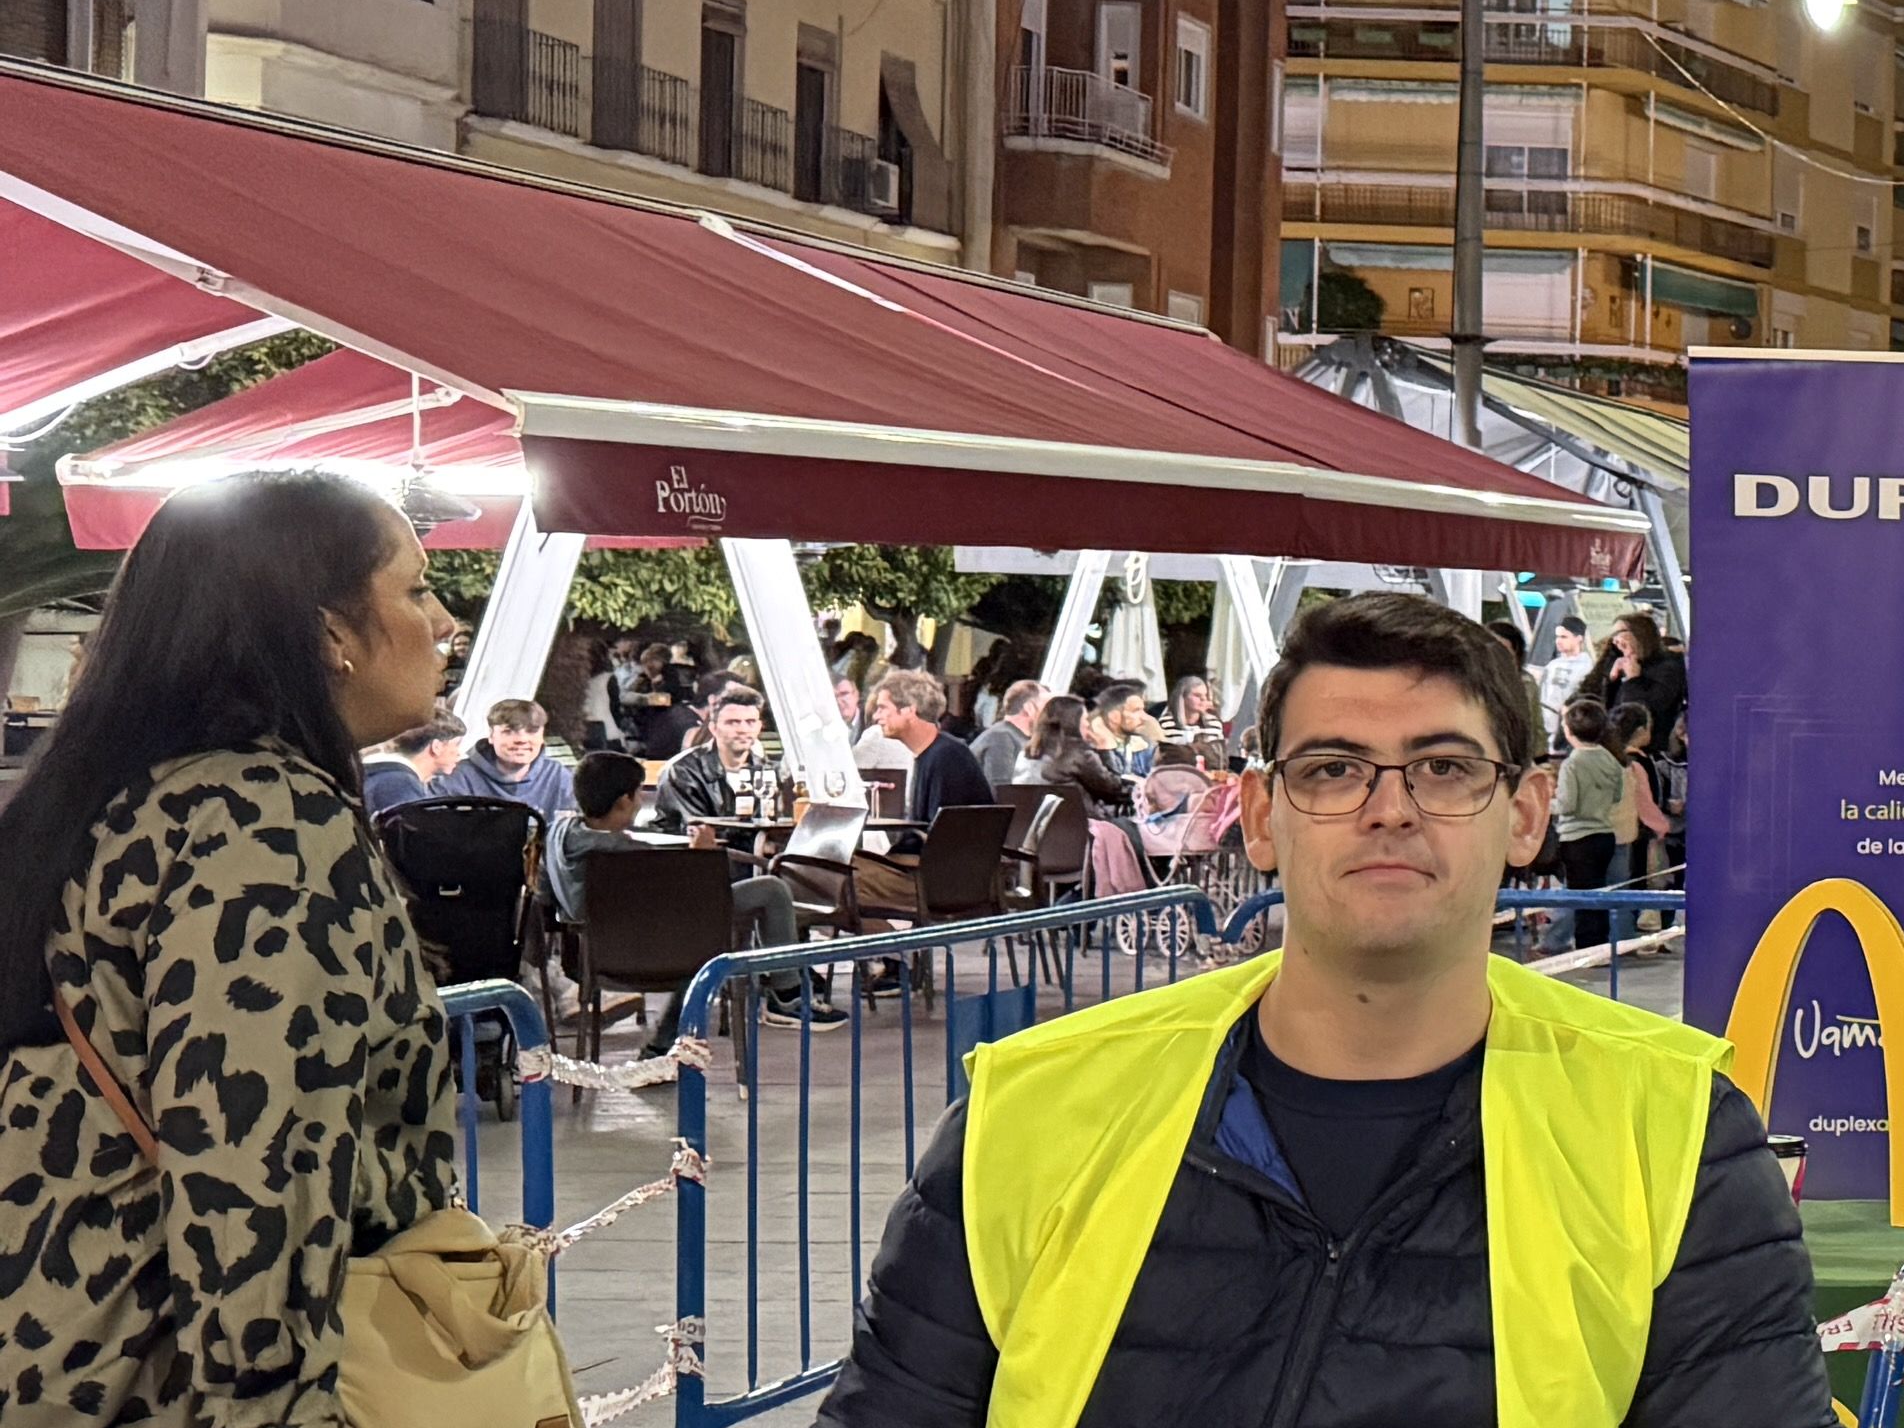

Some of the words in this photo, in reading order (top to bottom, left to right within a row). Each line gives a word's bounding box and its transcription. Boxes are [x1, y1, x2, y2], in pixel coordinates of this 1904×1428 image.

[656, 480, 722, 515] Portón
[1841, 799, 1859, 820] la
[1857, 837, 1883, 855] de
